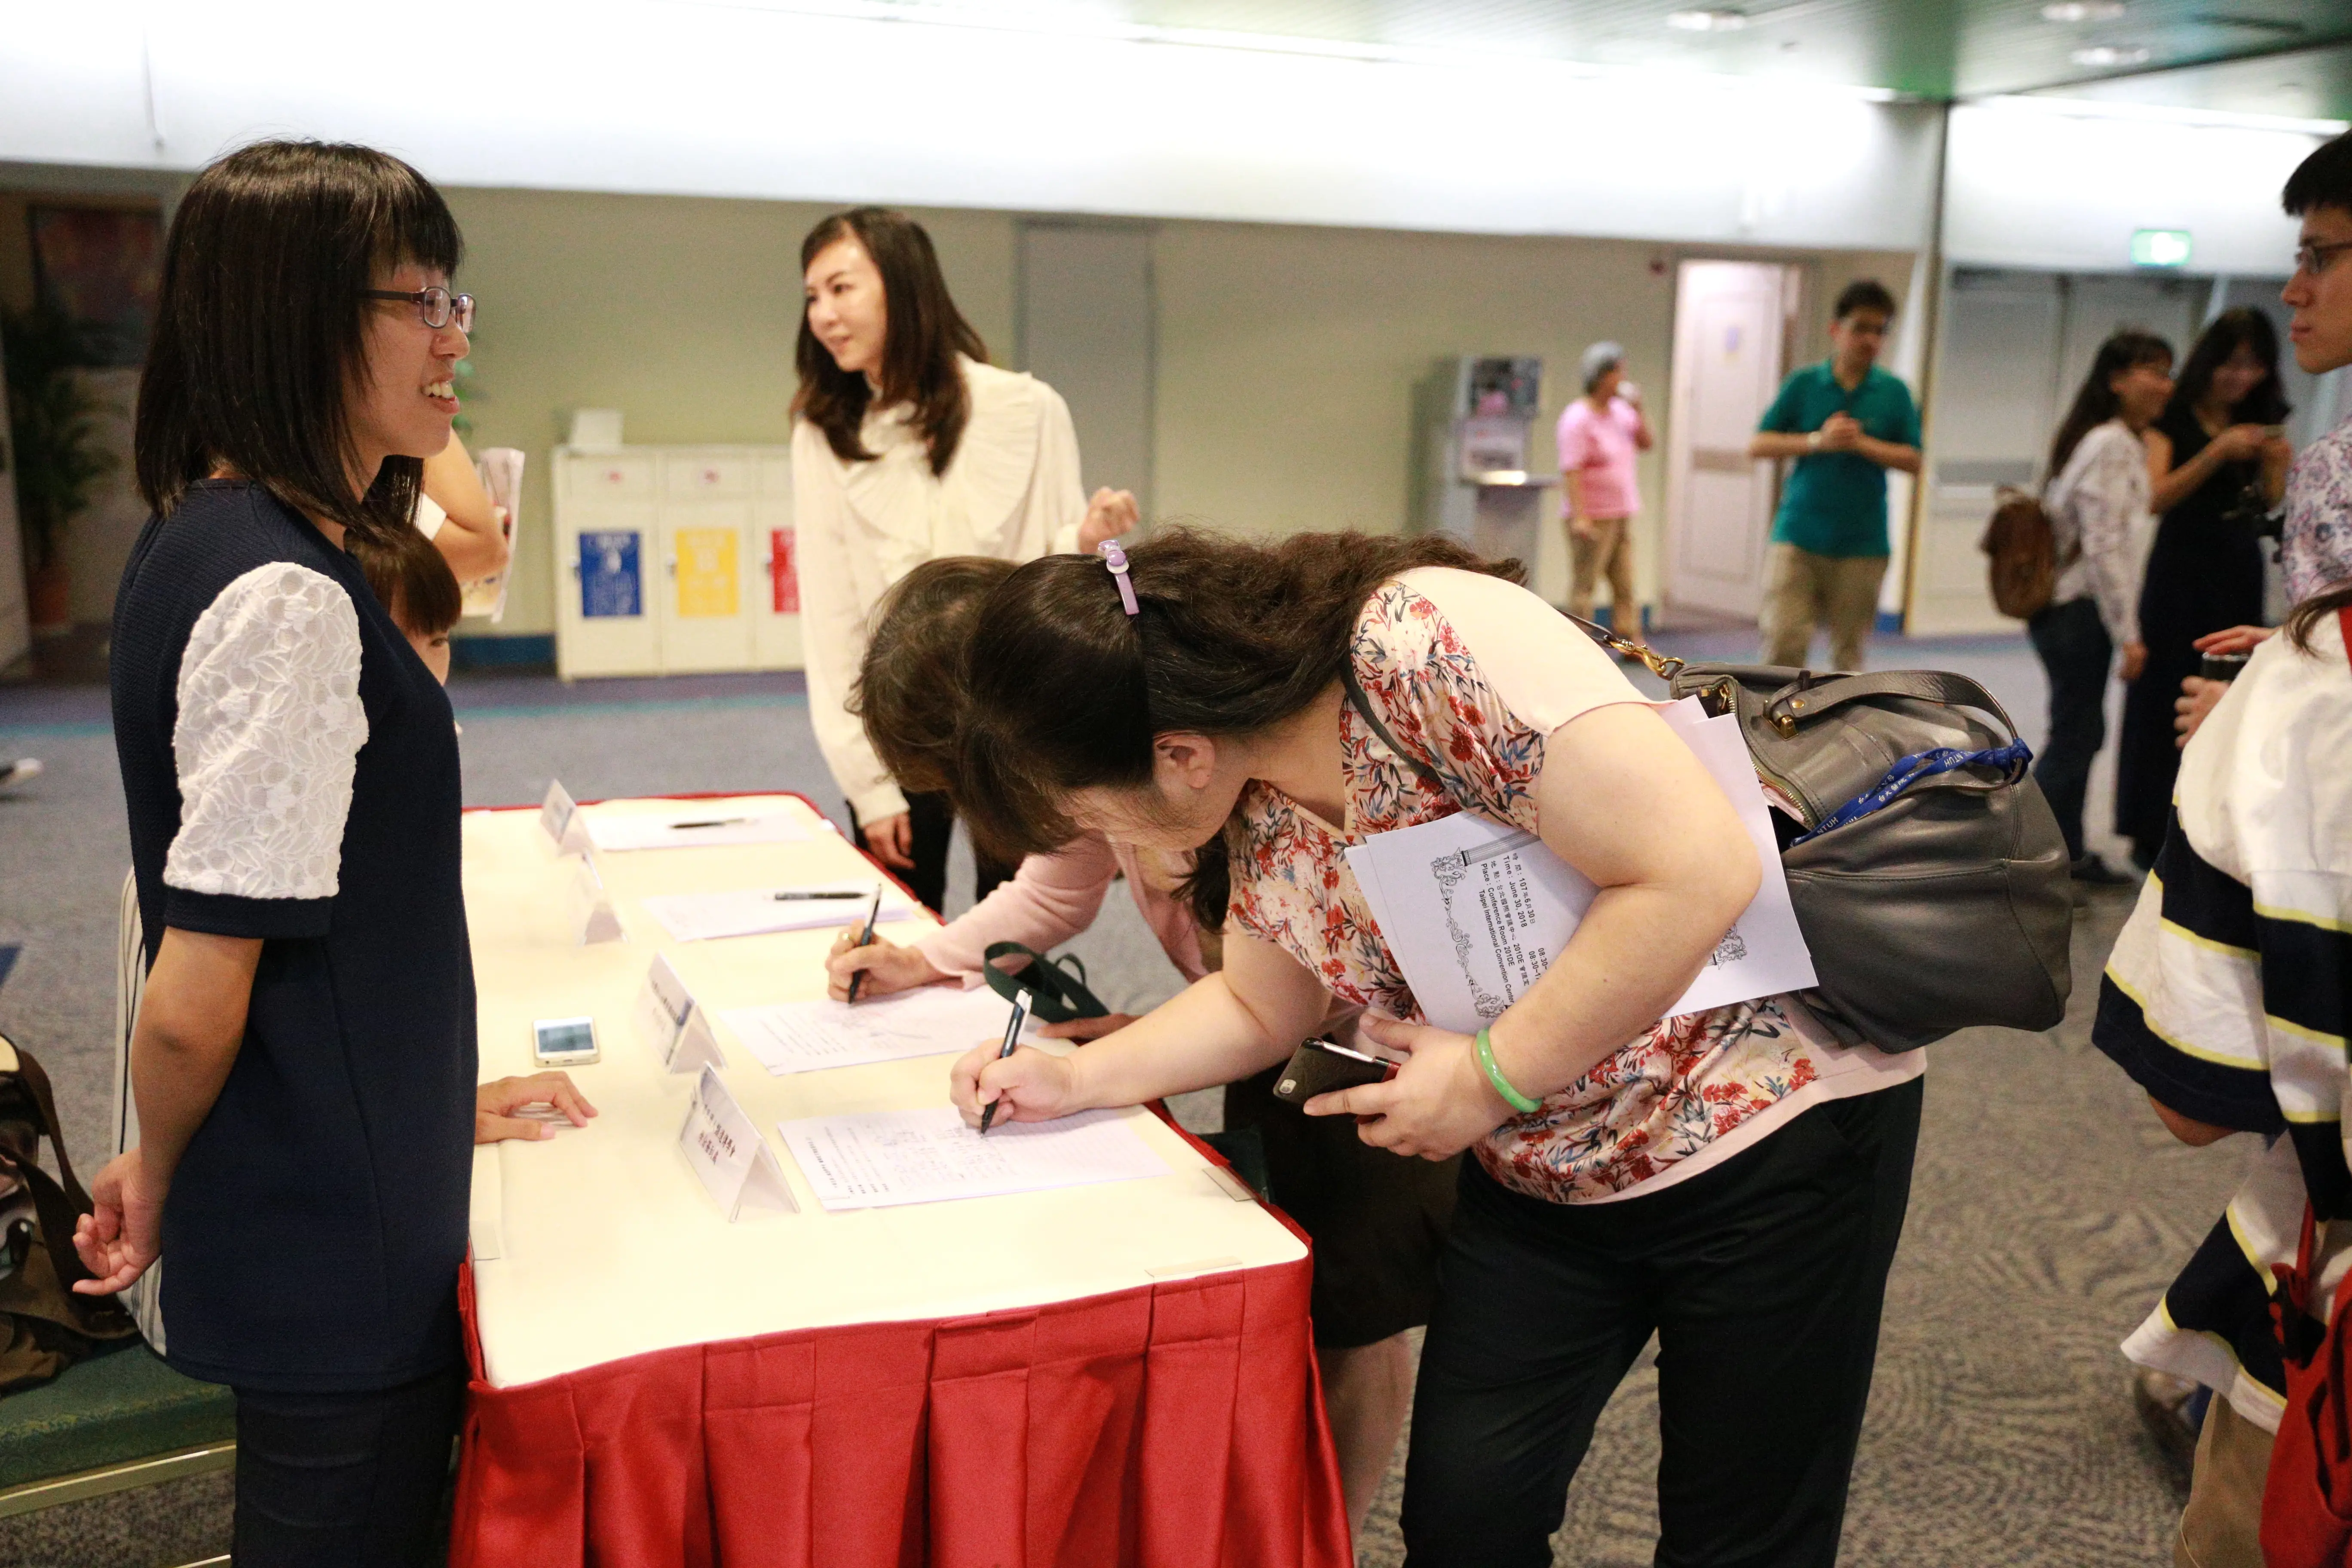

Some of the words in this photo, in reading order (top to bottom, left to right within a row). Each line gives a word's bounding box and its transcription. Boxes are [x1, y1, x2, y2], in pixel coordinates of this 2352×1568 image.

[1944, 752, 1963, 768] NTUH
[1817, 817, 1839, 835] NTUH
[1509, 882, 1518, 898] June
[1518, 911, 1528, 928] 2018
[1488, 888, 1502, 925] Conference
[1498, 925, 1507, 945] Room
[1504, 946, 1515, 967] 201DE
[1479, 889, 1489, 909] Taipei
[1484, 909, 1500, 948] International
[1495, 949, 1508, 983] Convention
[1505, 984, 1515, 1003] Center
[1513, 943, 1524, 964] 201DE
